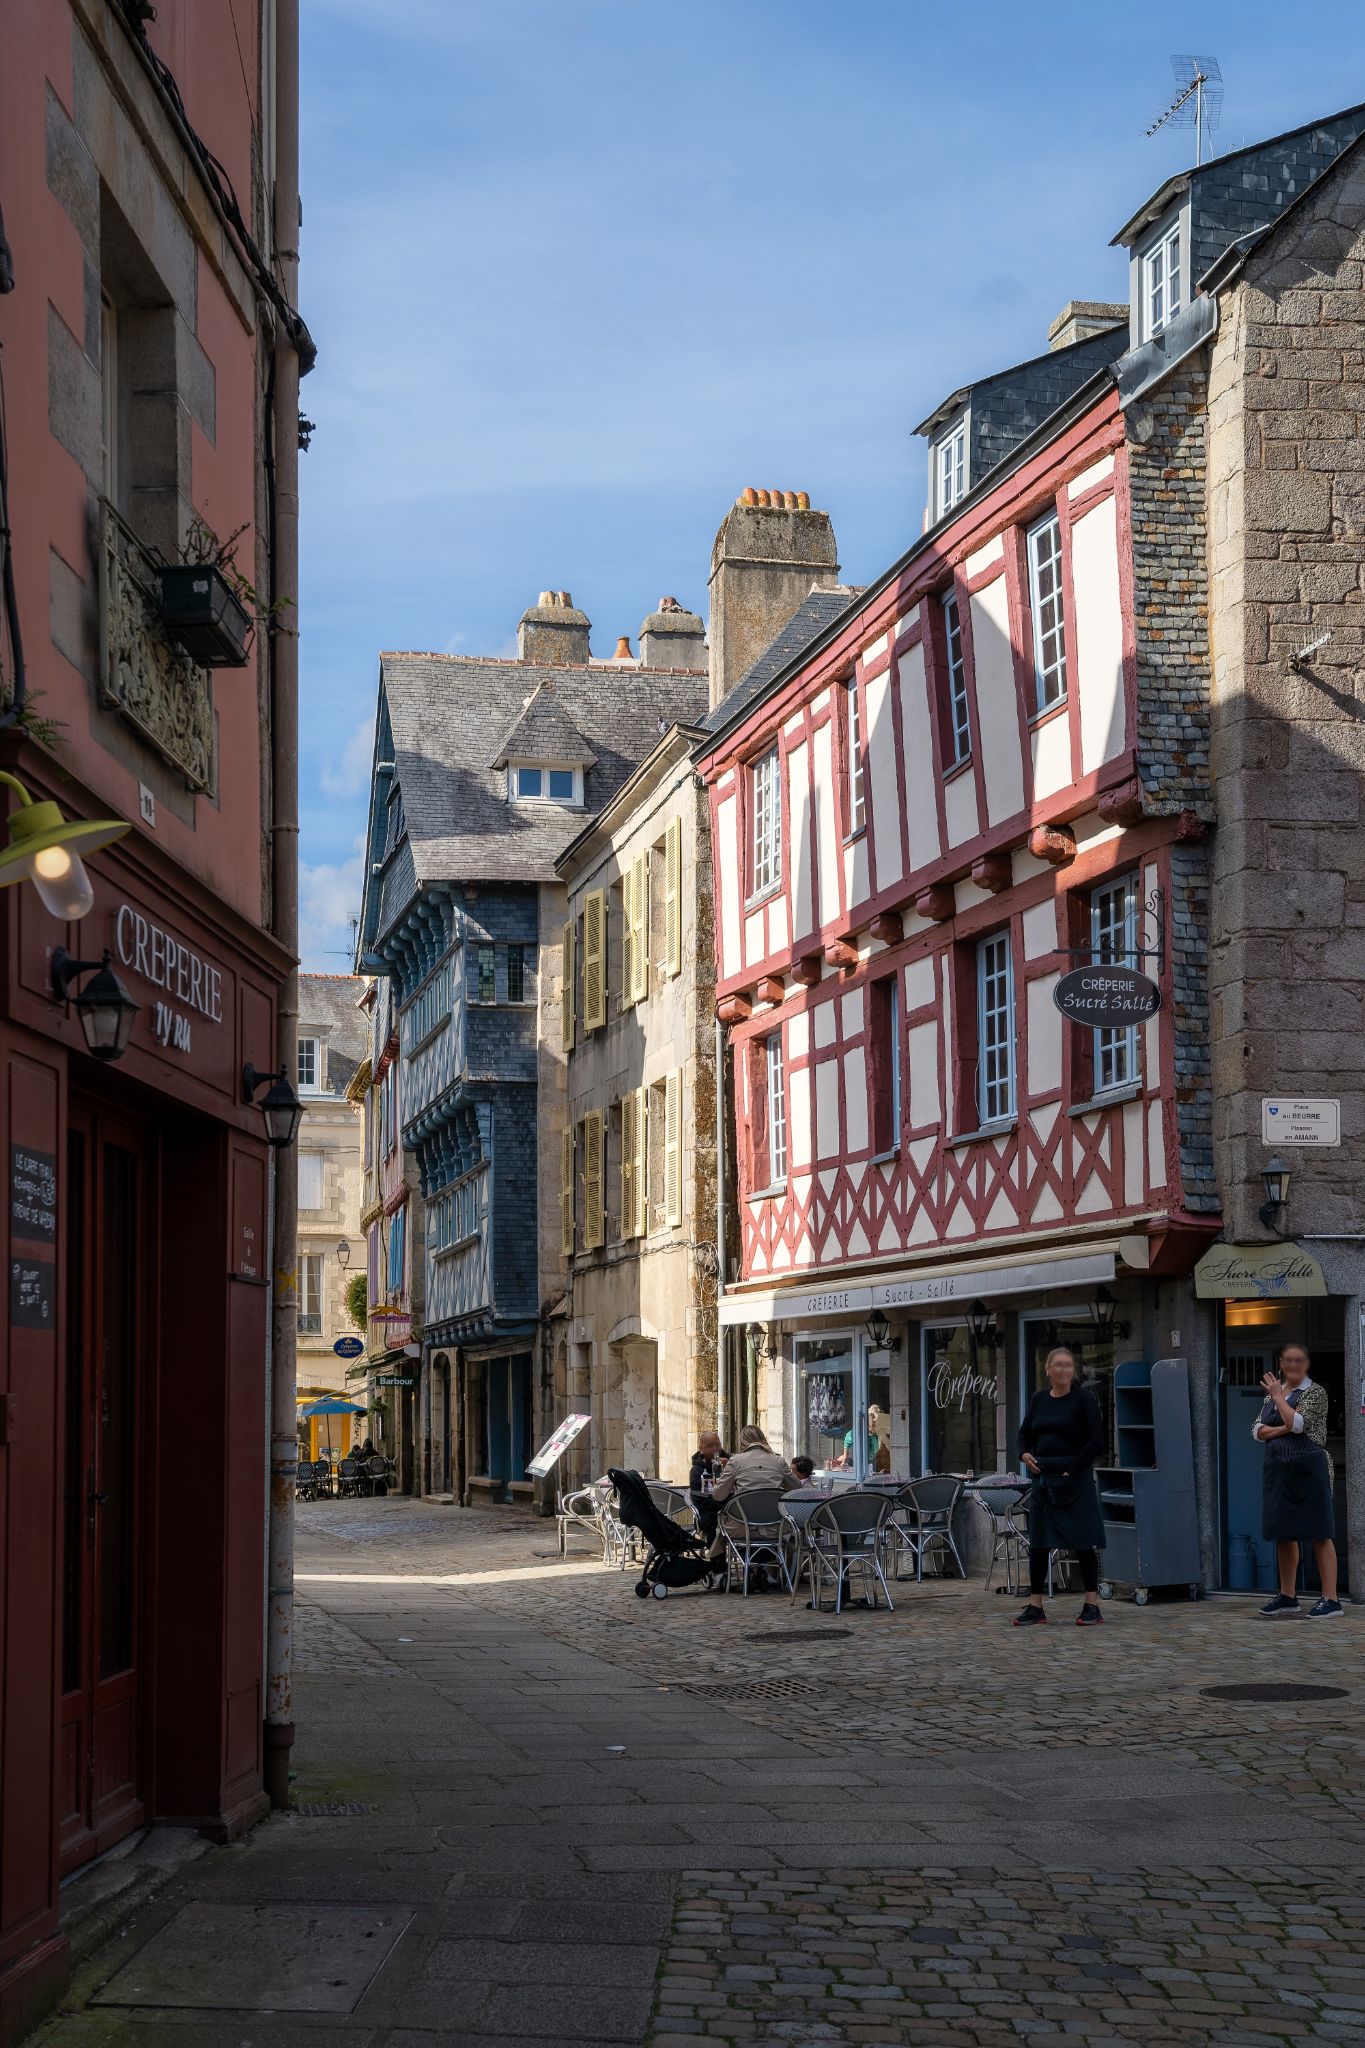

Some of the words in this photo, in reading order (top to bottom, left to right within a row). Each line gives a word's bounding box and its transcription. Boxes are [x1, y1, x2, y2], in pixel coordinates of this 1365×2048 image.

[117, 905, 222, 1023] CREPERIE
[1081, 976, 1135, 992] CRÊPERIE
[1063, 991, 1107, 1009] Sucré
[1111, 995, 1154, 1011] Sallé
[1200, 1257, 1258, 1282] Sucré
[1259, 1255, 1314, 1280] Sallé
[807, 1293, 849, 1312] CREPERIE
[885, 1285, 914, 1303] Sucré
[927, 1279, 955, 1299] Sallé
[379, 1377, 414, 1385] Barbour
